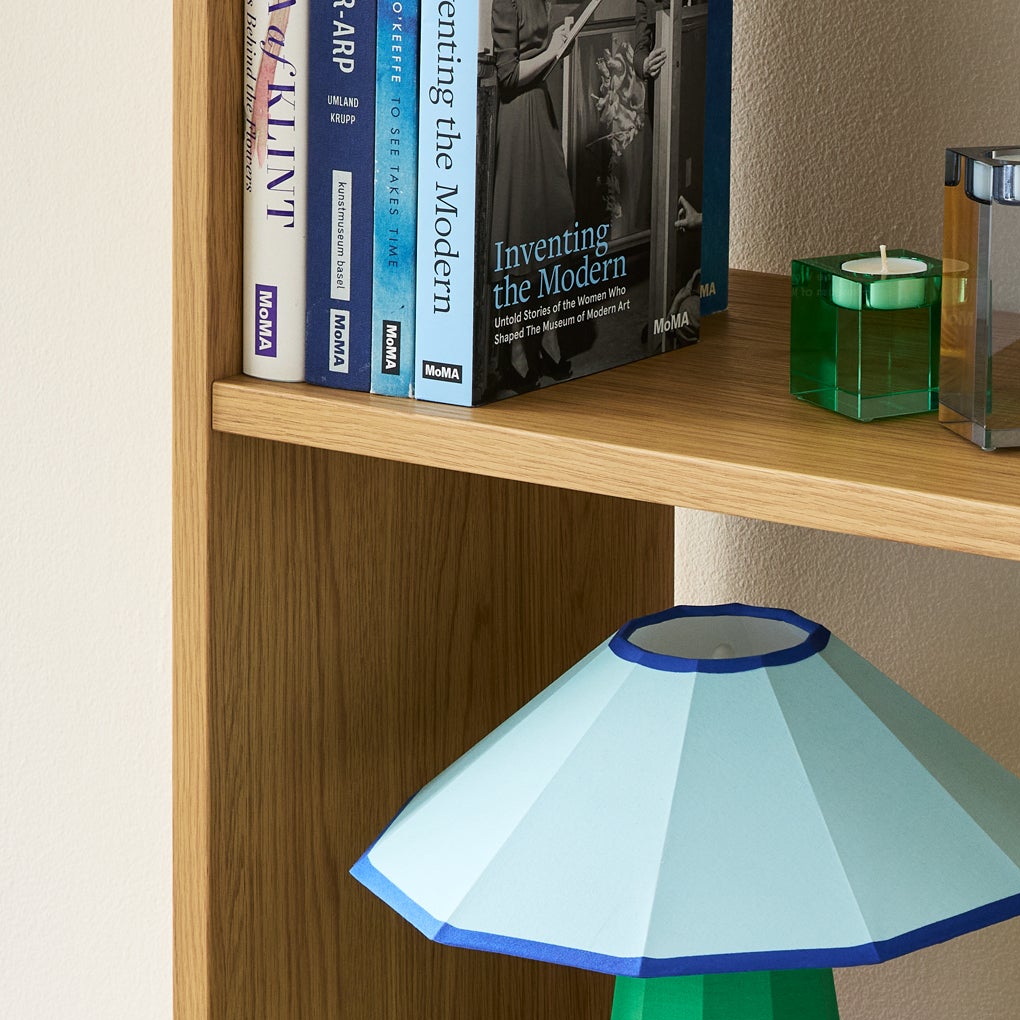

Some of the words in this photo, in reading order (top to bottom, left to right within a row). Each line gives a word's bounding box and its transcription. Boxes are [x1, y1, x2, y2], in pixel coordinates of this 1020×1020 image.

[246, 13, 257, 81] Behind
[391, 1, 403, 83] O'KEEFFE
[428, 0, 462, 108] enting
[246, 84, 257, 113] the
[327, 94, 359, 108] UMLAND
[330, 112, 356, 125] KRUPP
[390, 97, 400, 118] TO
[245, 119, 257, 193] Flowers
[266, 81, 296, 228] KLINT
[390, 127, 400, 156] SEE
[435, 117, 461, 170] the
[388, 165, 400, 215] TAKES
[336, 181, 347, 257] kunstmuseum
[388, 228, 399, 268] TIME
[433, 181, 460, 314] Modern
[494, 221, 610, 273] Inventing
[336, 260, 346, 289] basel
[493, 275, 531, 310] the
[537, 255, 627, 299] Modern
[700, 281, 716, 299] MA
[258, 290, 273, 351] MoMA
[494, 313, 522, 329] Untold
[523, 304, 551, 321] Stories
[552, 300, 562, 313] of
[562, 298, 576, 312] the
[577, 290, 607, 306] Women
[608, 285, 627, 299] Who
[494, 329, 525, 345] Shaped
[525, 324, 541, 337] The
[542, 315, 575, 332] Museum
[576, 311, 585, 323] of
[586, 304, 617, 320] Modern
[617, 299, 631, 312] Art
[653, 311, 689, 335] MoMA
[333, 314, 346, 367] MoMA
[385, 324, 398, 370] MoMA
[425, 363, 460, 380] MoMA
